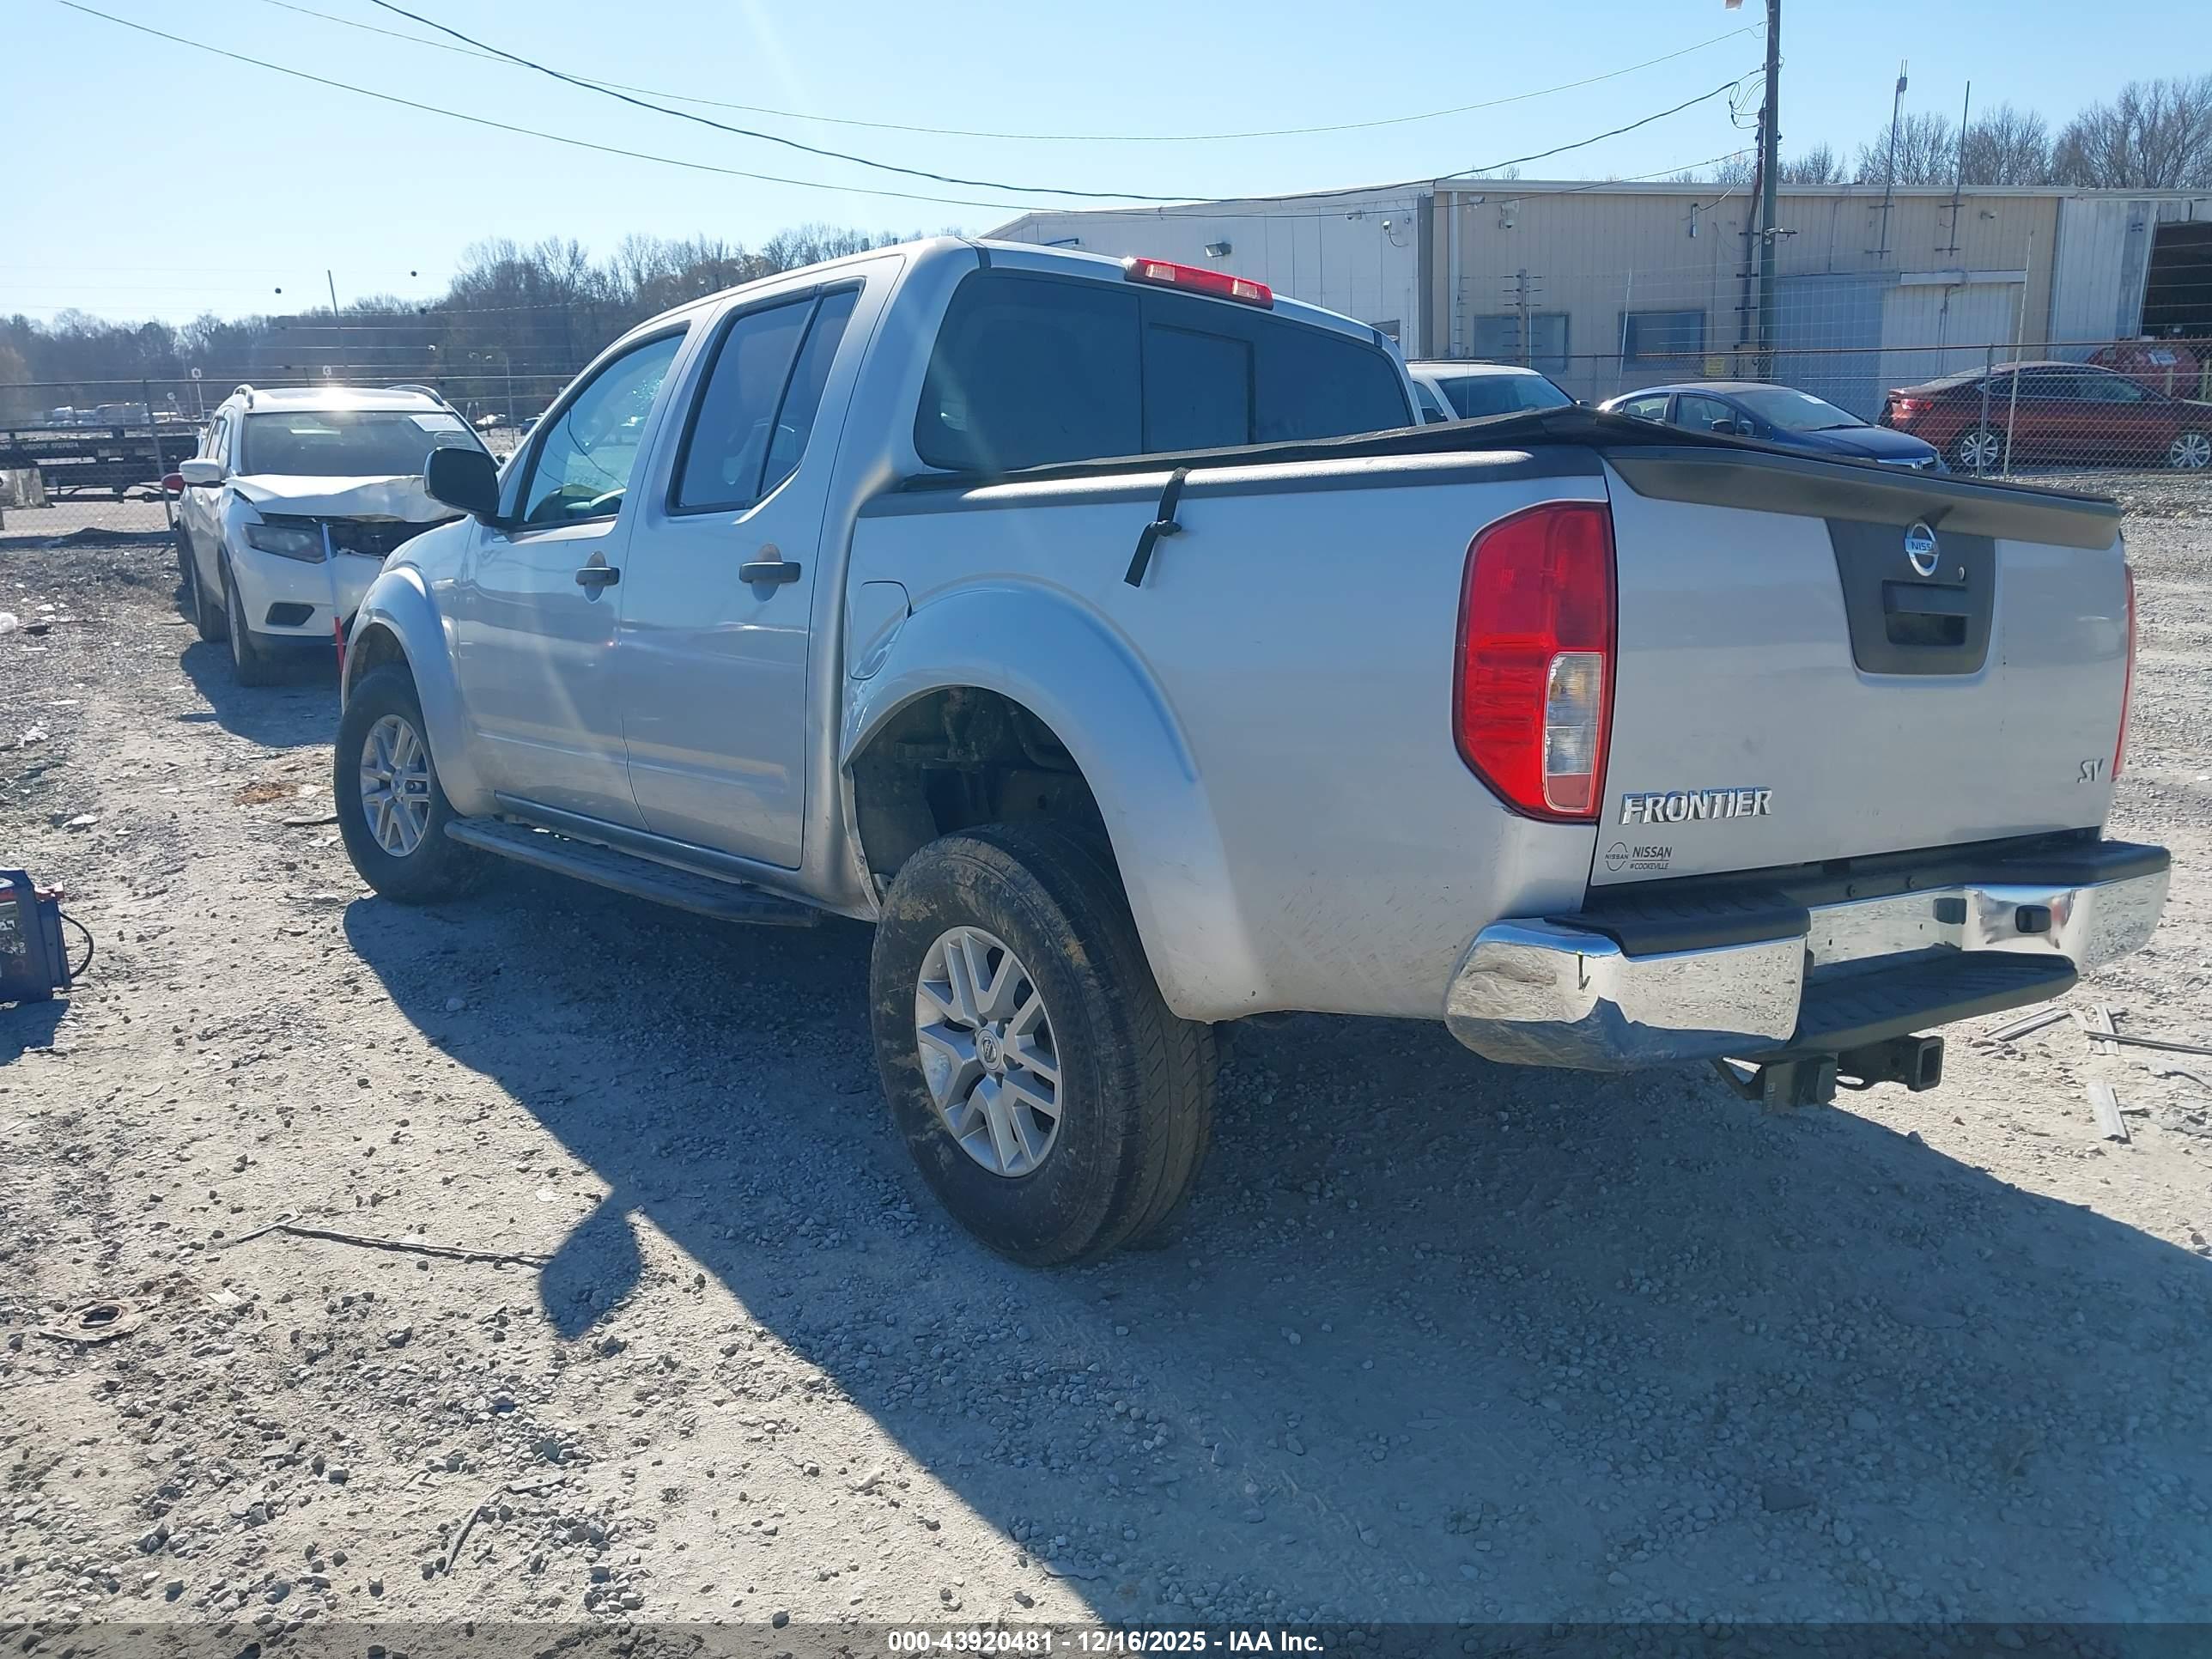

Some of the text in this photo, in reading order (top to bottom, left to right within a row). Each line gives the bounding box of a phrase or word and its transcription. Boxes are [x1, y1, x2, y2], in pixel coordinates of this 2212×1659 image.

[2077, 757, 2104, 783] SV
[1619, 786, 1773, 825] FRONTIER
[1632, 846, 1673, 858] NISSAN
